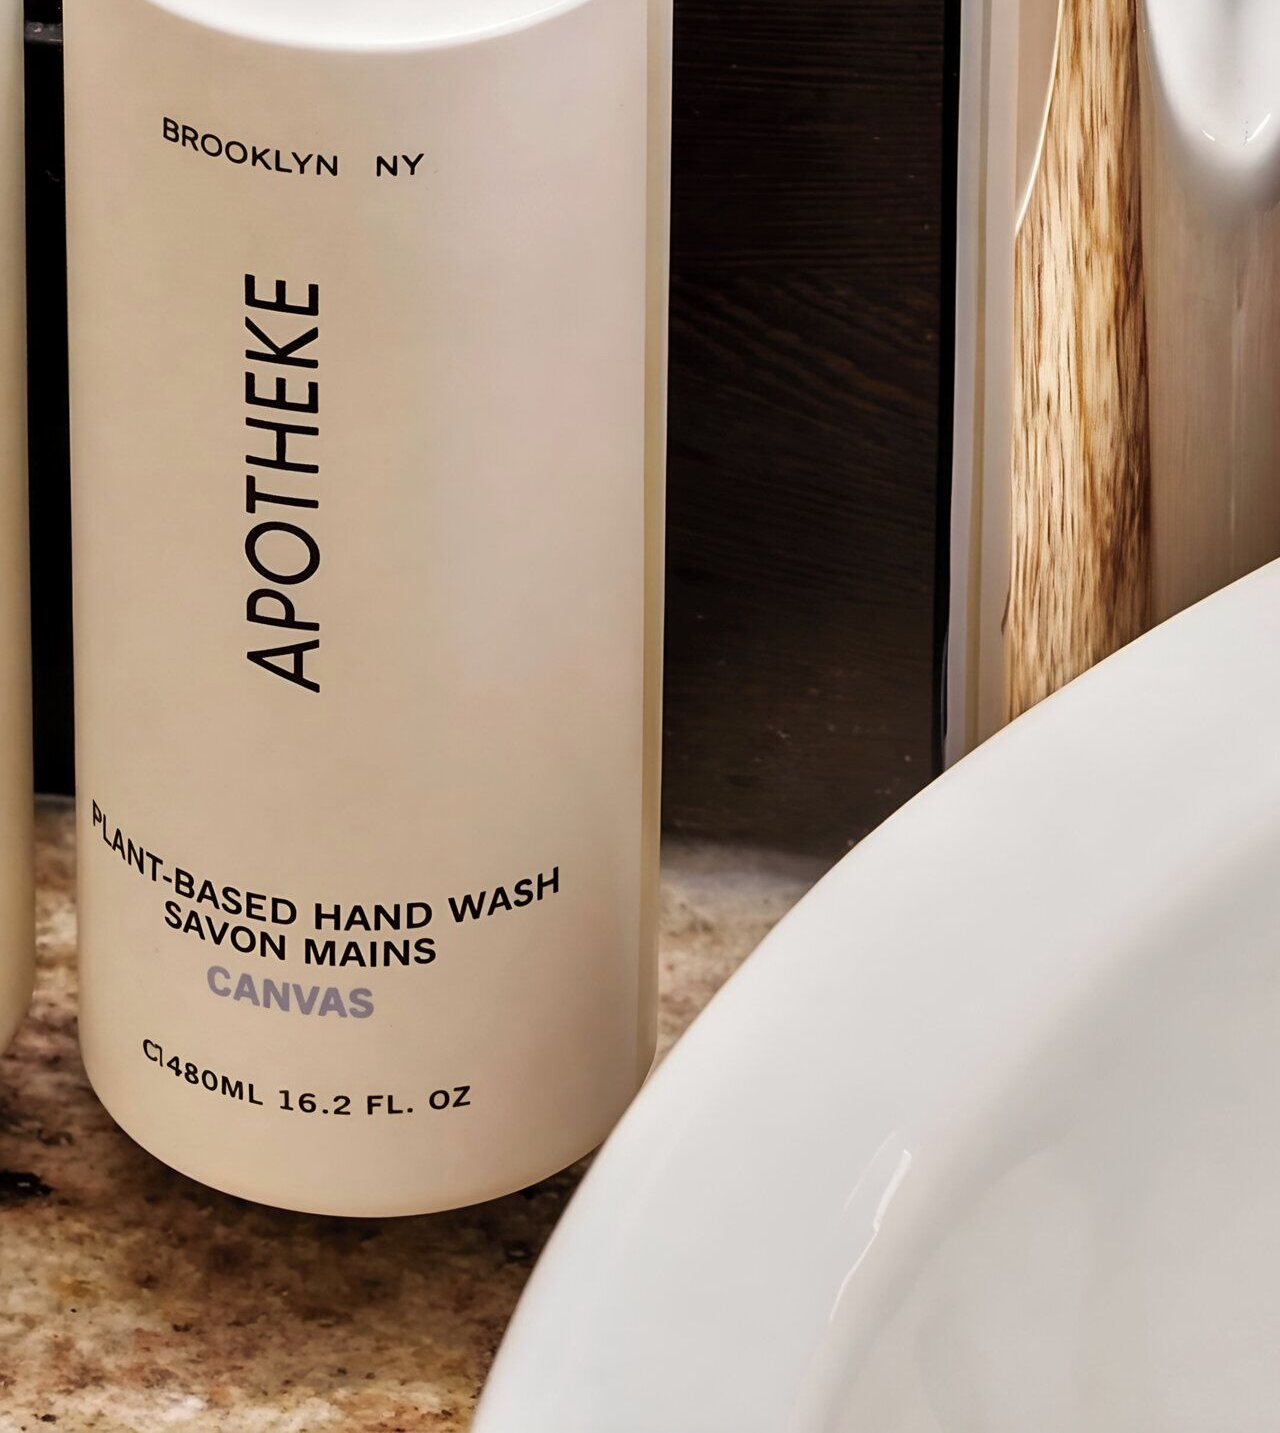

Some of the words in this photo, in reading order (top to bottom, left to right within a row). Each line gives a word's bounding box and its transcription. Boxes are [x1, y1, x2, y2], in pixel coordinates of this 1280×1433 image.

[162, 116, 338, 177] BROOKLYN
[376, 153, 425, 178] NY
[244, 273, 321, 694] APOTHEKE
[92, 798, 298, 925] PLANT-BASED
[314, 901, 433, 932] HAND
[447, 865, 559, 923] WASH
[164, 900, 286, 961] SAVON
[304, 937, 437, 968] MAINS
[207, 966, 375, 1019] CANVAS
[278, 1089, 351, 1116] 16.2
[366, 1094, 414, 1116] FL.
[428, 1085, 471, 1111] OZ
